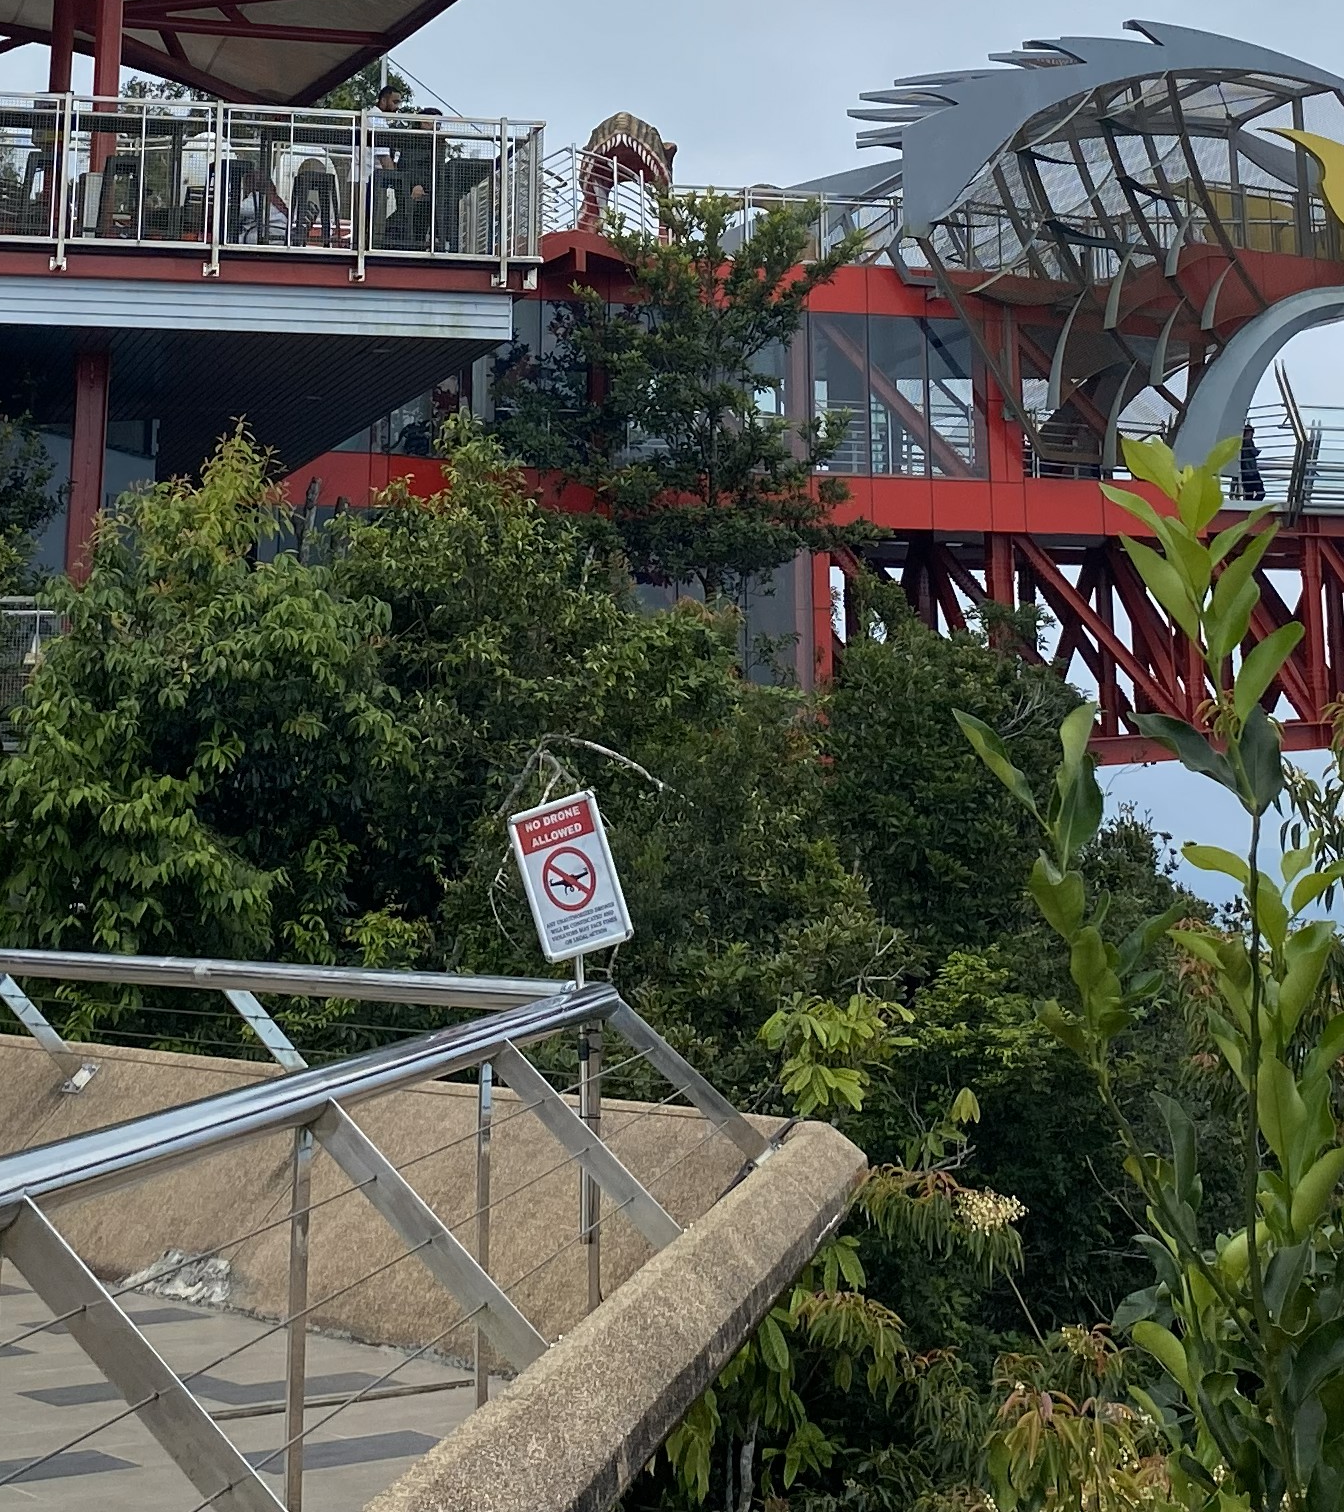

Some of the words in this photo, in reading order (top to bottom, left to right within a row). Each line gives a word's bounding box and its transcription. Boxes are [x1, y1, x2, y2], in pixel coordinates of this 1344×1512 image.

[525, 819, 541, 833] NO
[542, 805, 581, 825] DRONE
[531, 822, 583, 848] ALLOWED
